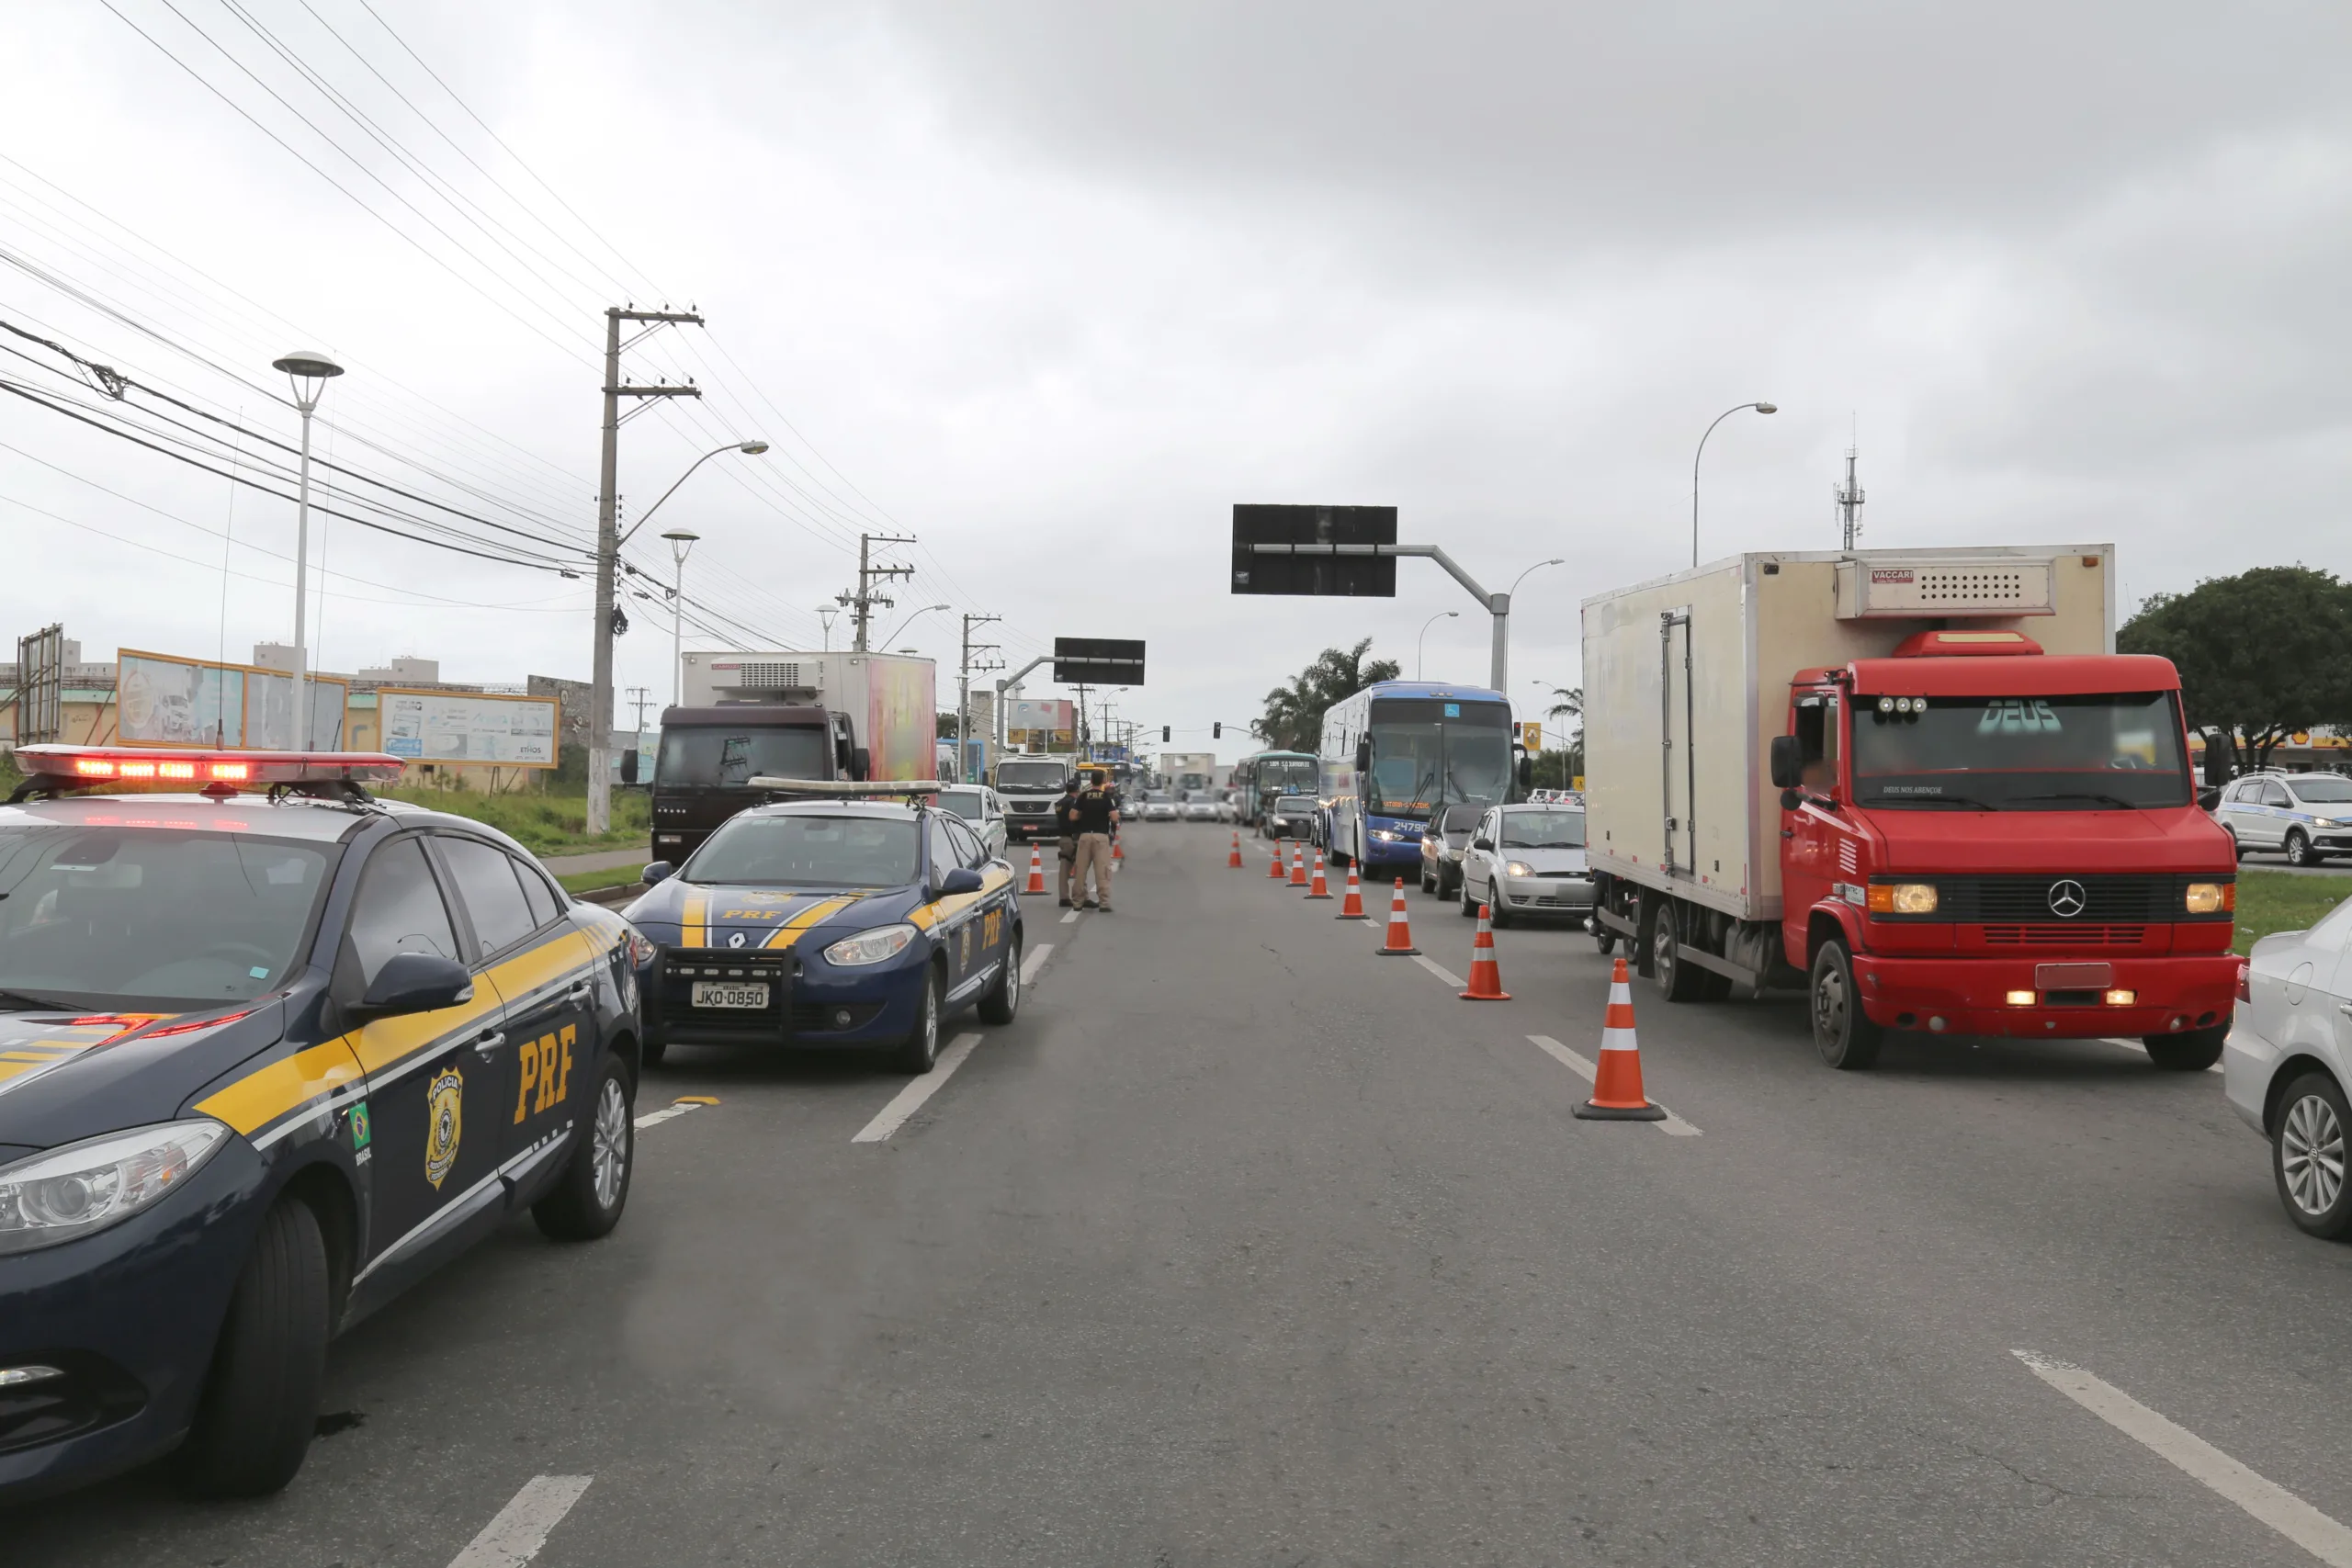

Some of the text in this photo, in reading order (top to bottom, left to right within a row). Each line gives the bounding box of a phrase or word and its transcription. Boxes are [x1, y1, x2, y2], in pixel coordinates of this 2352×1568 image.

[1873, 570, 1913, 579] VACCARI
[1978, 700, 2063, 734] DEUS
[722, 910, 782, 919] PRF
[982, 907, 1001, 951] PRF
[514, 1023, 576, 1125] PRF
[356, 1146, 371, 1167] BRASIL
